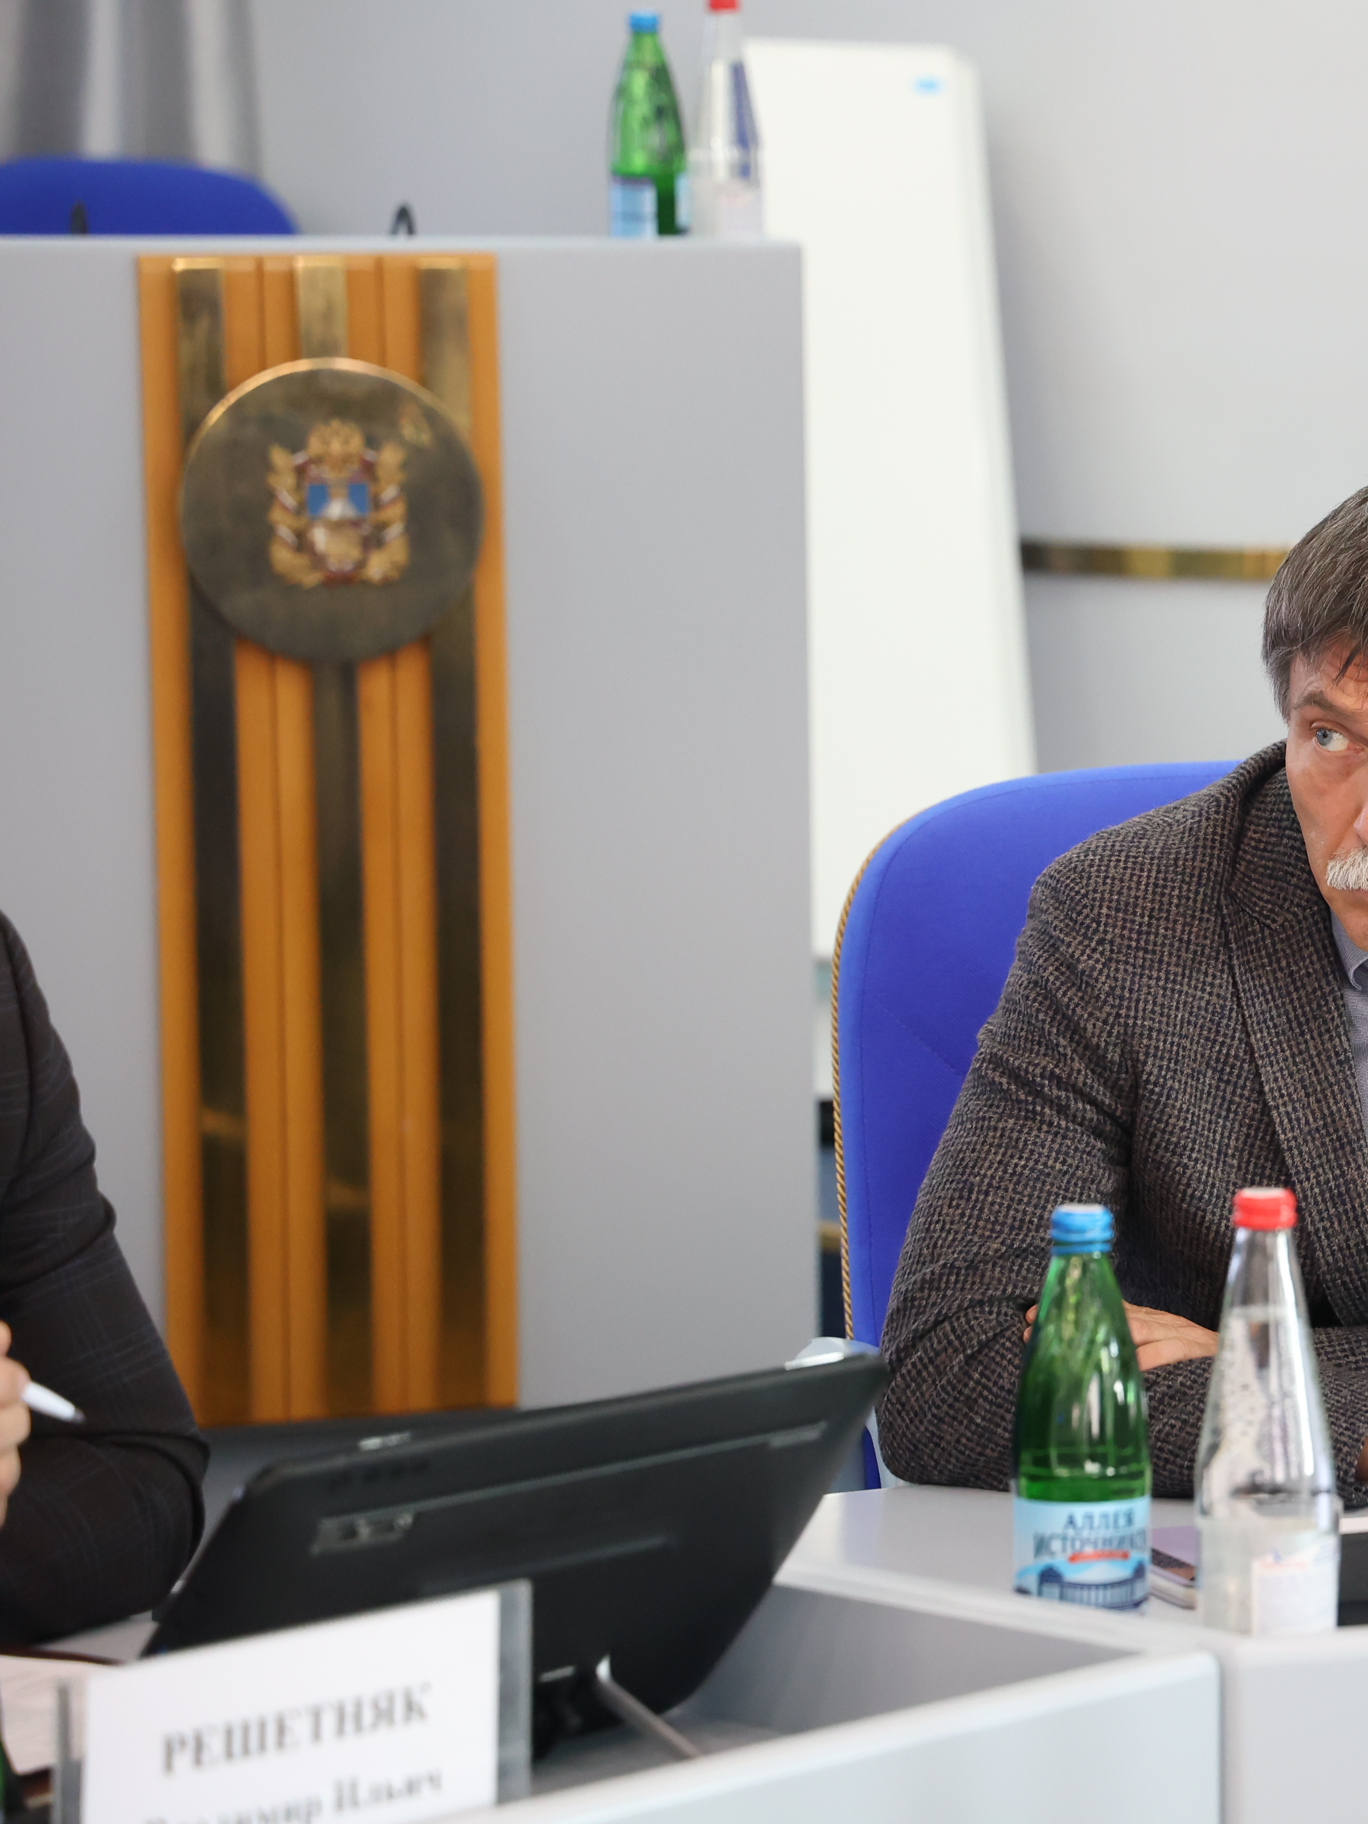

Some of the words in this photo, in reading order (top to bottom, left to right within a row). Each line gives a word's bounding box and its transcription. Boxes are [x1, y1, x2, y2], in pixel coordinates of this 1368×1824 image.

[1063, 1509, 1135, 1531] АЛЛЕЯ
[163, 1681, 432, 1776] РЕШЕТНЯК
[332, 1768, 442, 1813] Ильич
